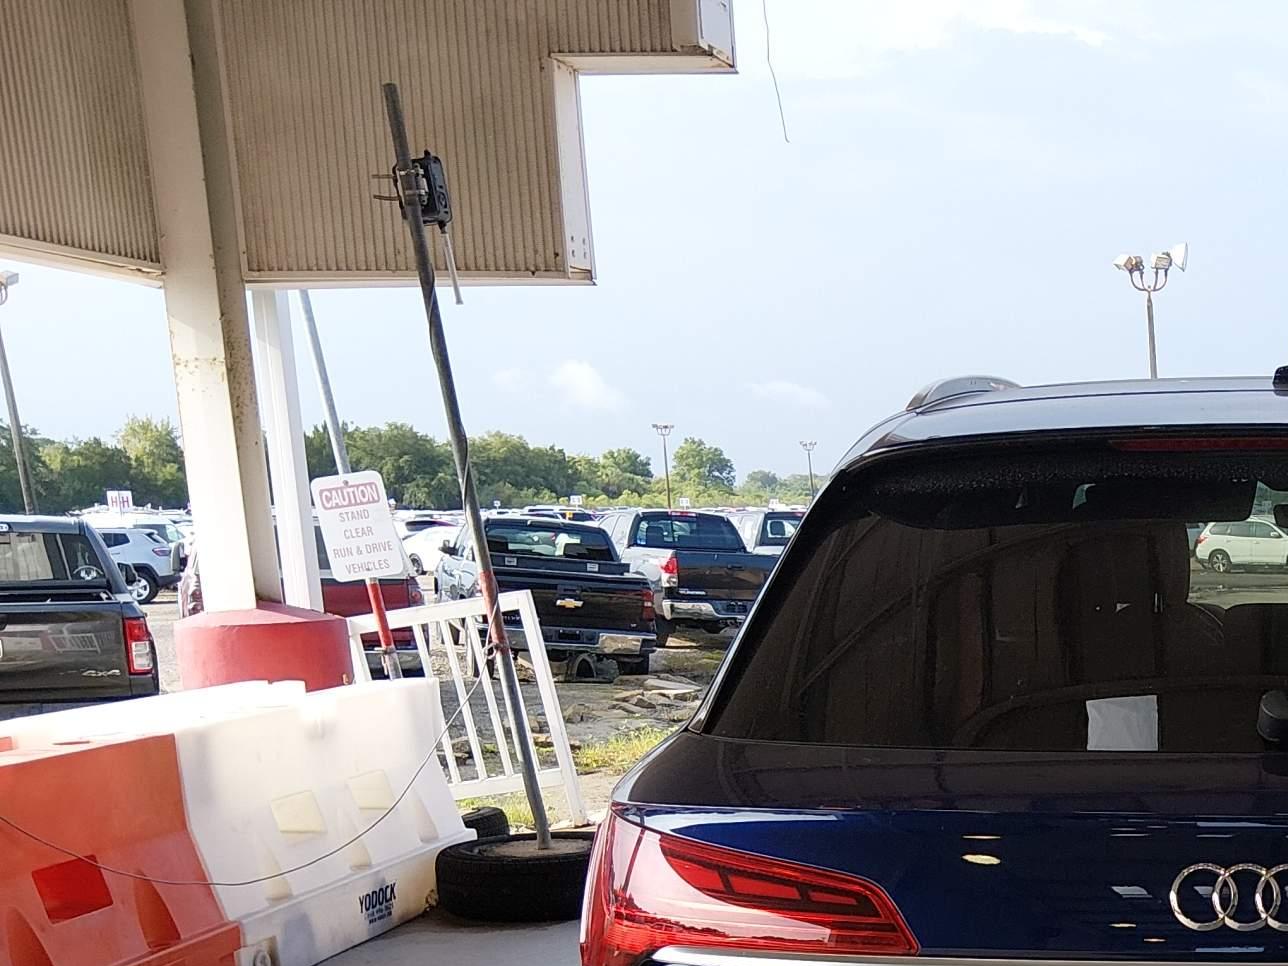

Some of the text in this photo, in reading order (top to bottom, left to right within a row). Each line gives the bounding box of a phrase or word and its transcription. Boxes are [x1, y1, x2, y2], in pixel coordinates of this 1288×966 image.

[322, 485, 379, 508] CAUTION
[339, 509, 370, 522] STAND
[343, 526, 374, 539] CLEAR
[333, 541, 393, 559] RUN & DRIVE
[345, 559, 391, 574] VEHICLES
[359, 882, 396, 913] YODOCK
